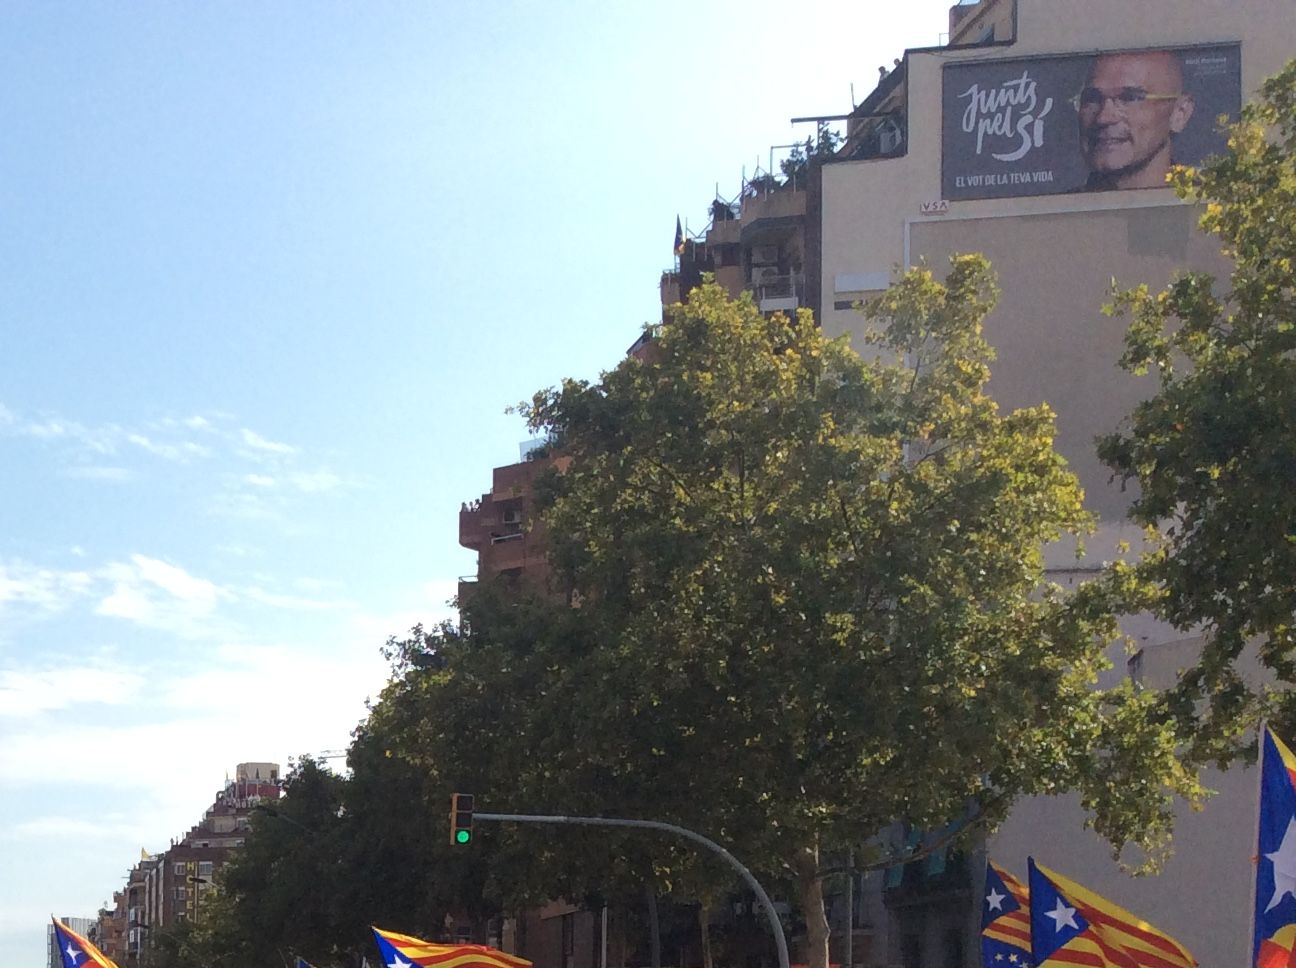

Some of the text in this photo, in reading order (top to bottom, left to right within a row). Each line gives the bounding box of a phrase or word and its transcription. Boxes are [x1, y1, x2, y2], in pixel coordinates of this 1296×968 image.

[976, 106, 1015, 154] pel
[955, 170, 1053, 187] EL VOT DE LA TEVA VIDA
